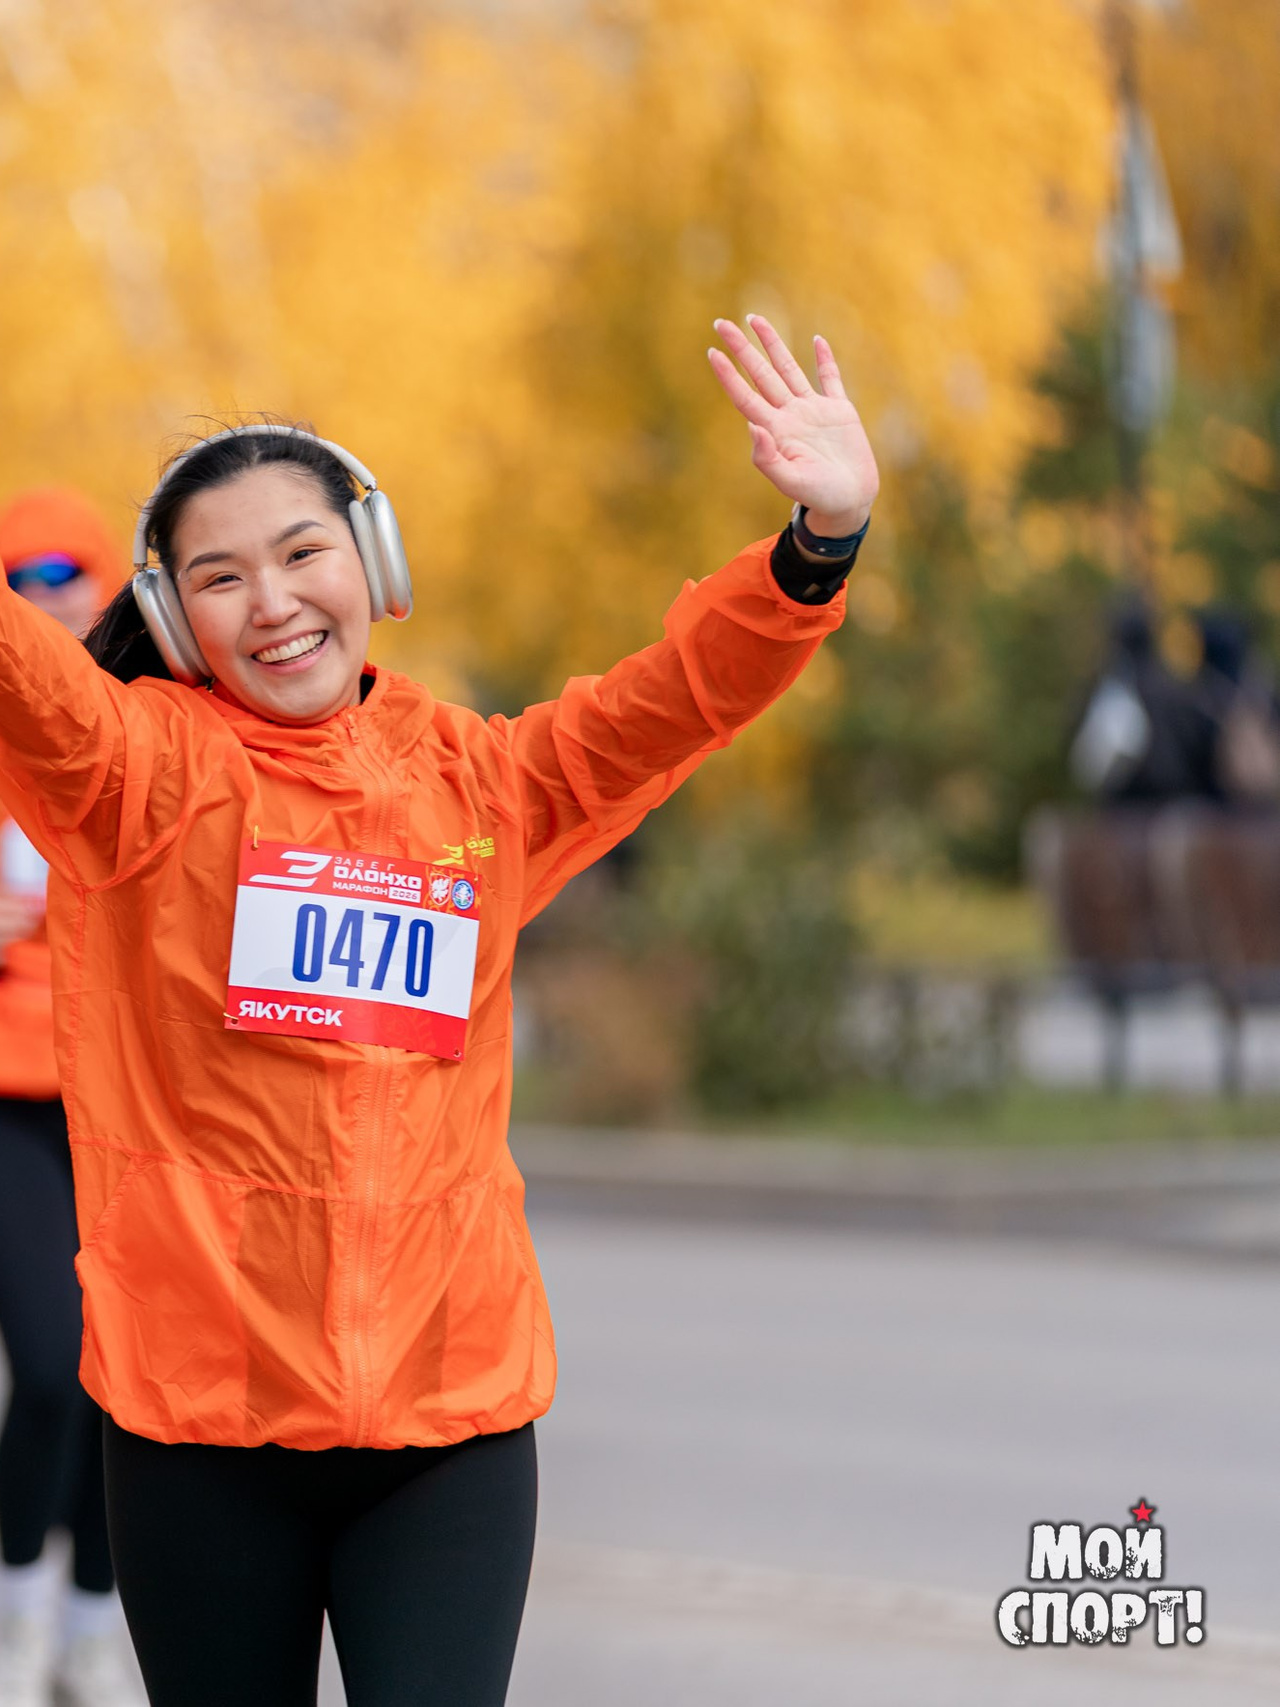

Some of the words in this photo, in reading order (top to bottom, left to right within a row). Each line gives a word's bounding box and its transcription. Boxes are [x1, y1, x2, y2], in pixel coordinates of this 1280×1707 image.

[334, 856, 395, 871] ЗАБЕГ
[333, 865, 422, 890] ОЛОНХО
[332, 881, 388, 896] МАРАФОН
[391, 889, 418, 900] 2026
[292, 903, 434, 998] 0470
[238, 1000, 343, 1027] ЯКУТСК
